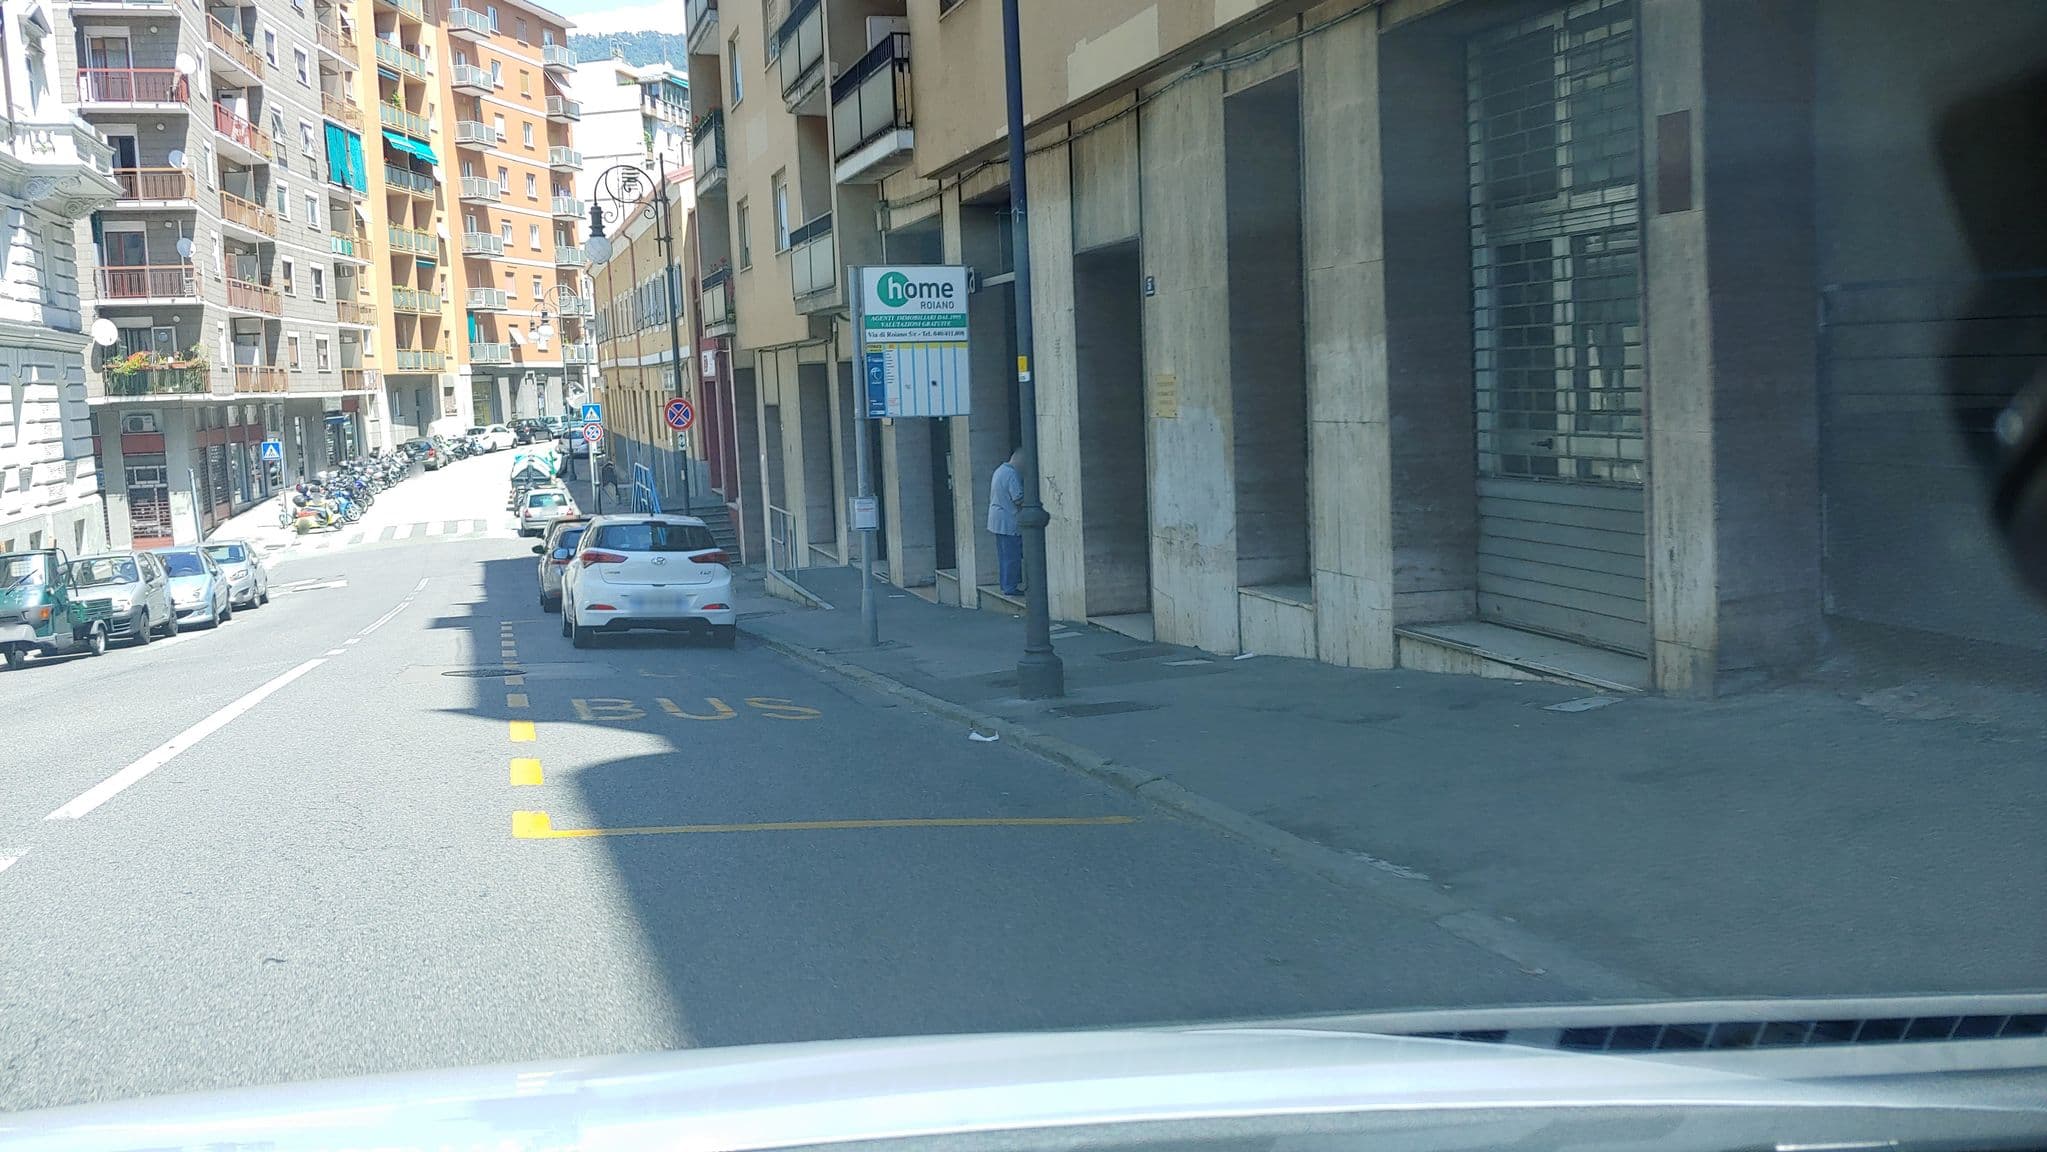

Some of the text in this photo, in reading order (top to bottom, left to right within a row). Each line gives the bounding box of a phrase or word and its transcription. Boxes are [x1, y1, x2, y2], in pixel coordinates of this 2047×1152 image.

[887, 276, 954, 300] home
[920, 301, 954, 310] ROIANO
[879, 330, 886, 338] di
[886, 330, 908, 338] Roiano
[571, 697, 822, 721] BUS
